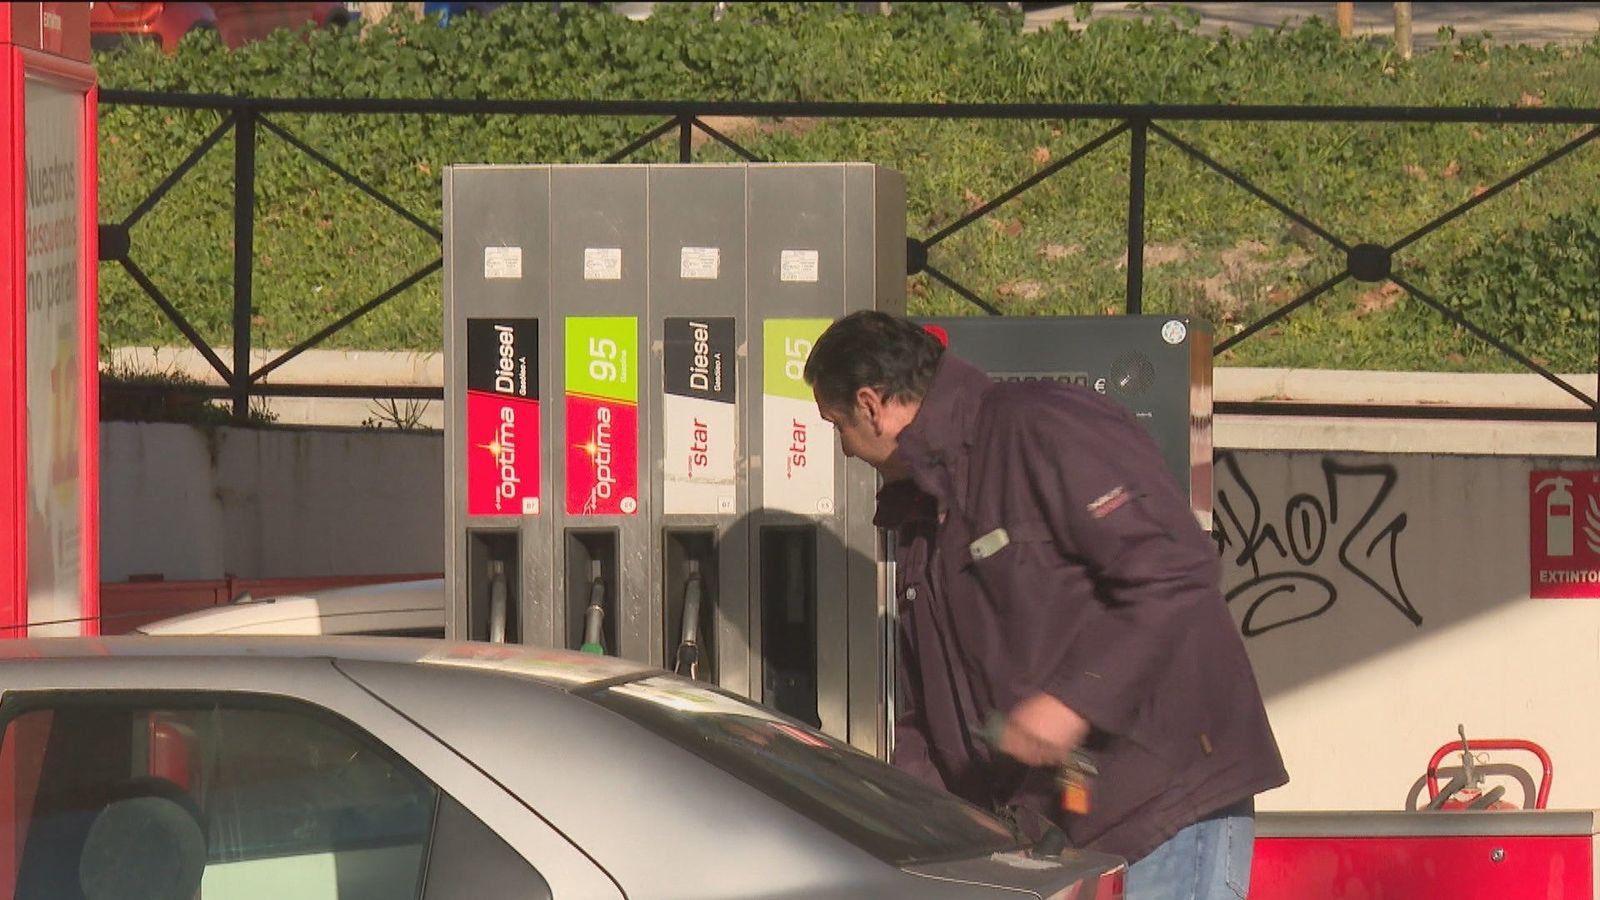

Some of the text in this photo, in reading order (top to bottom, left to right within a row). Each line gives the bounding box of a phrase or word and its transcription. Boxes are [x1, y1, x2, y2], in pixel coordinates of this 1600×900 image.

[27, 270, 43, 313] no
[494, 325, 514, 394] Diesel
[589, 336, 617, 382] 95
[689, 321, 709, 390] Diesel
[499, 406, 520, 499] optima
[595, 406, 617, 499] optima
[690, 418, 708, 467] star
[789, 418, 807, 467] star
